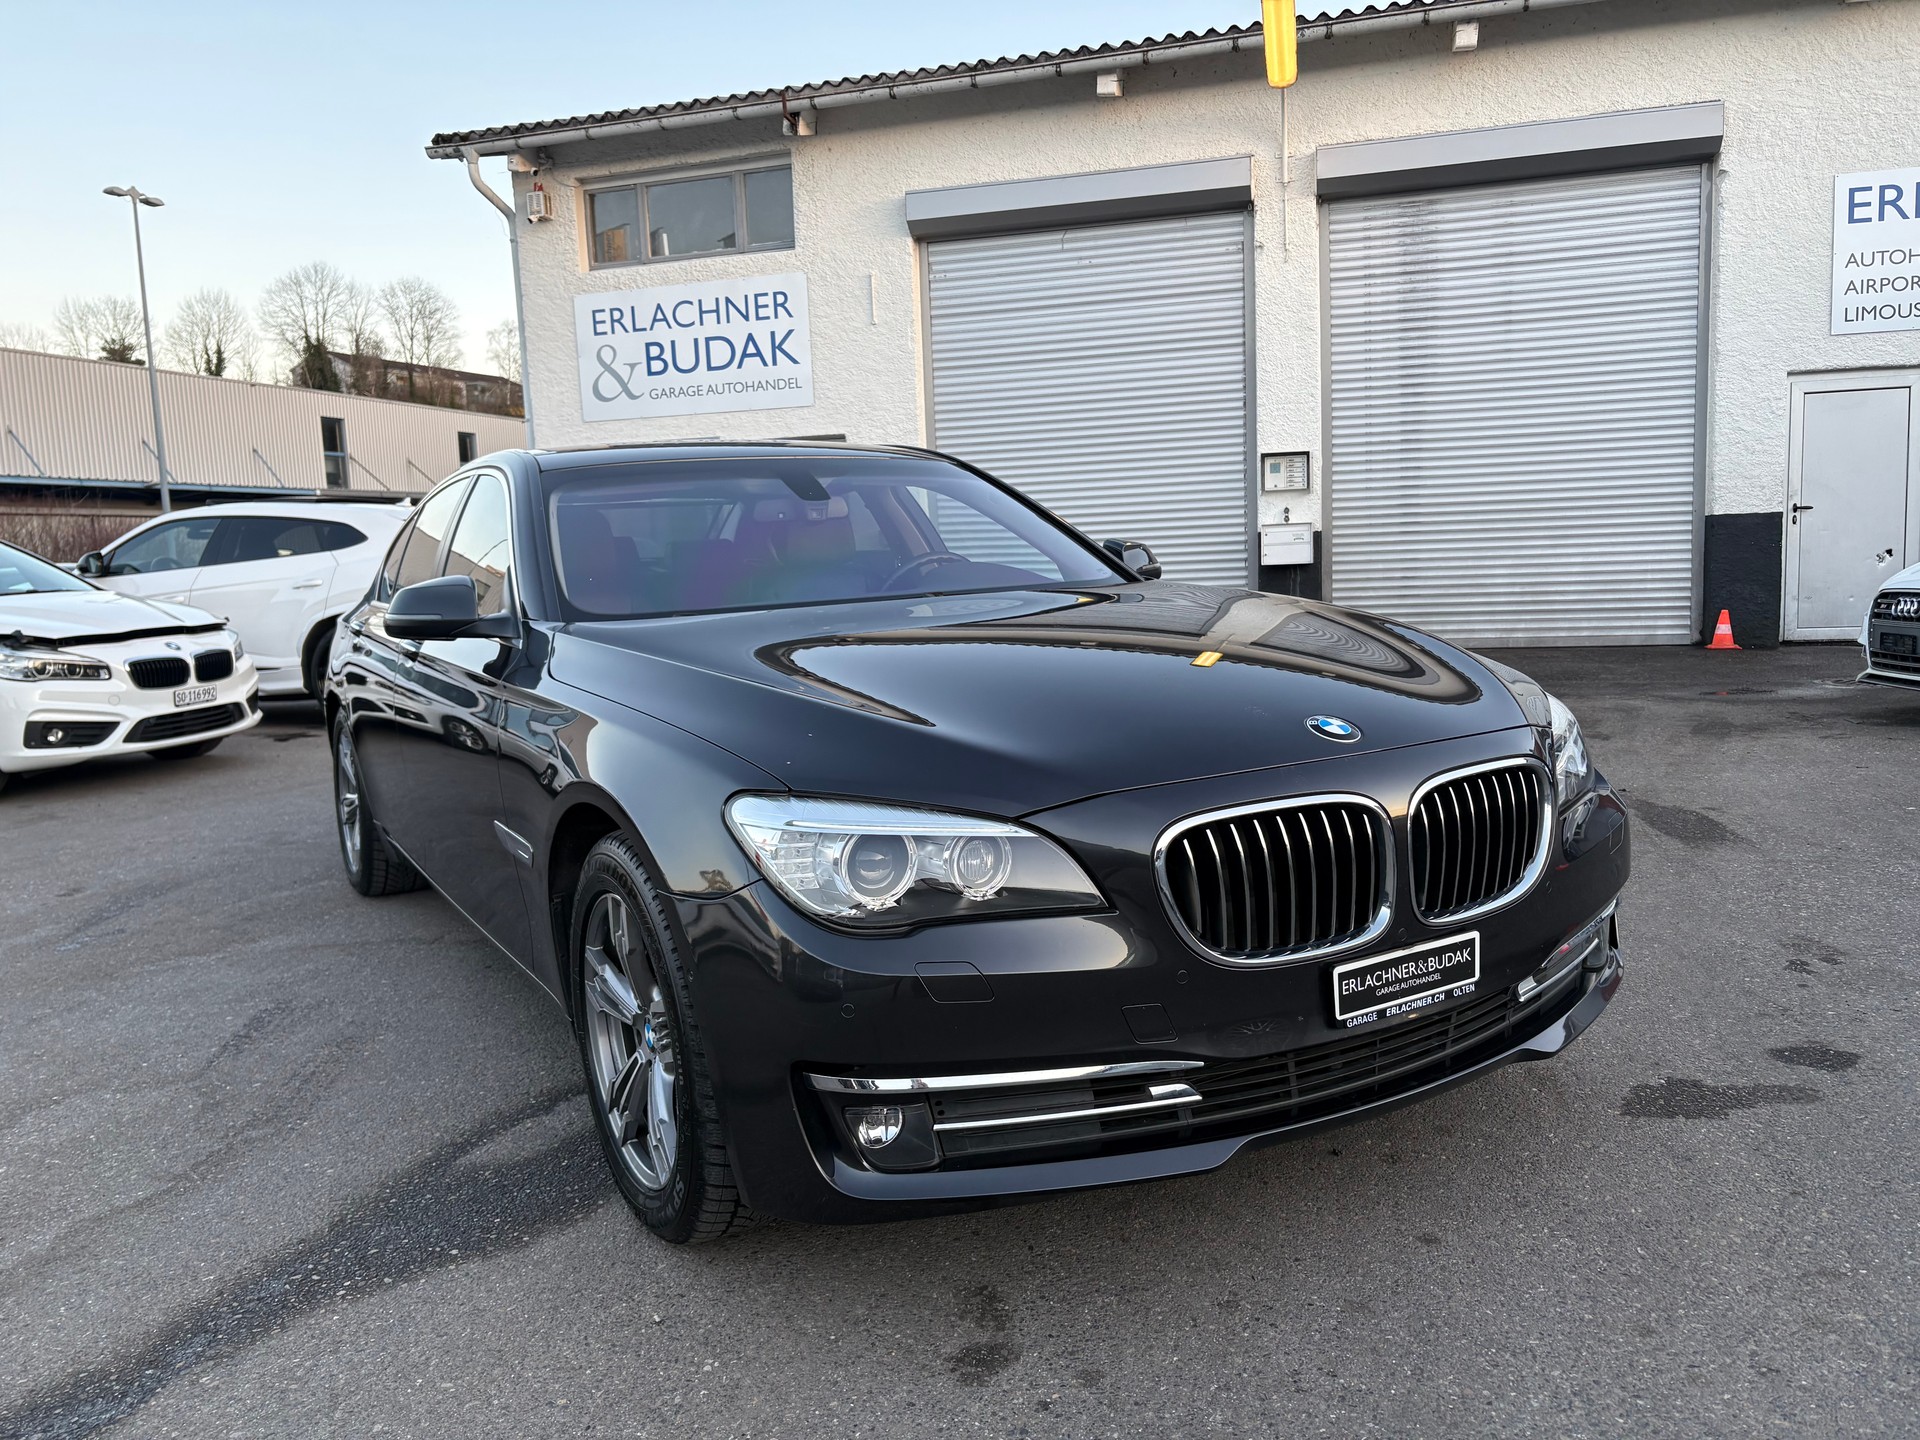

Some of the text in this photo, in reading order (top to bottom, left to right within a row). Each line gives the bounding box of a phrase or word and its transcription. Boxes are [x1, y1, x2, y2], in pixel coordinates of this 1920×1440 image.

[591, 290, 794, 337] ERLACHNER
[592, 328, 801, 403] & BUDAK
[649, 377, 802, 400] GARAGE AUTOHANDEL
[1346, 983, 1476, 1028] GARAGE ERLACHNER.CH OLTEN
[1375, 972, 1442, 997] GARAGE AUTOHANDEL
